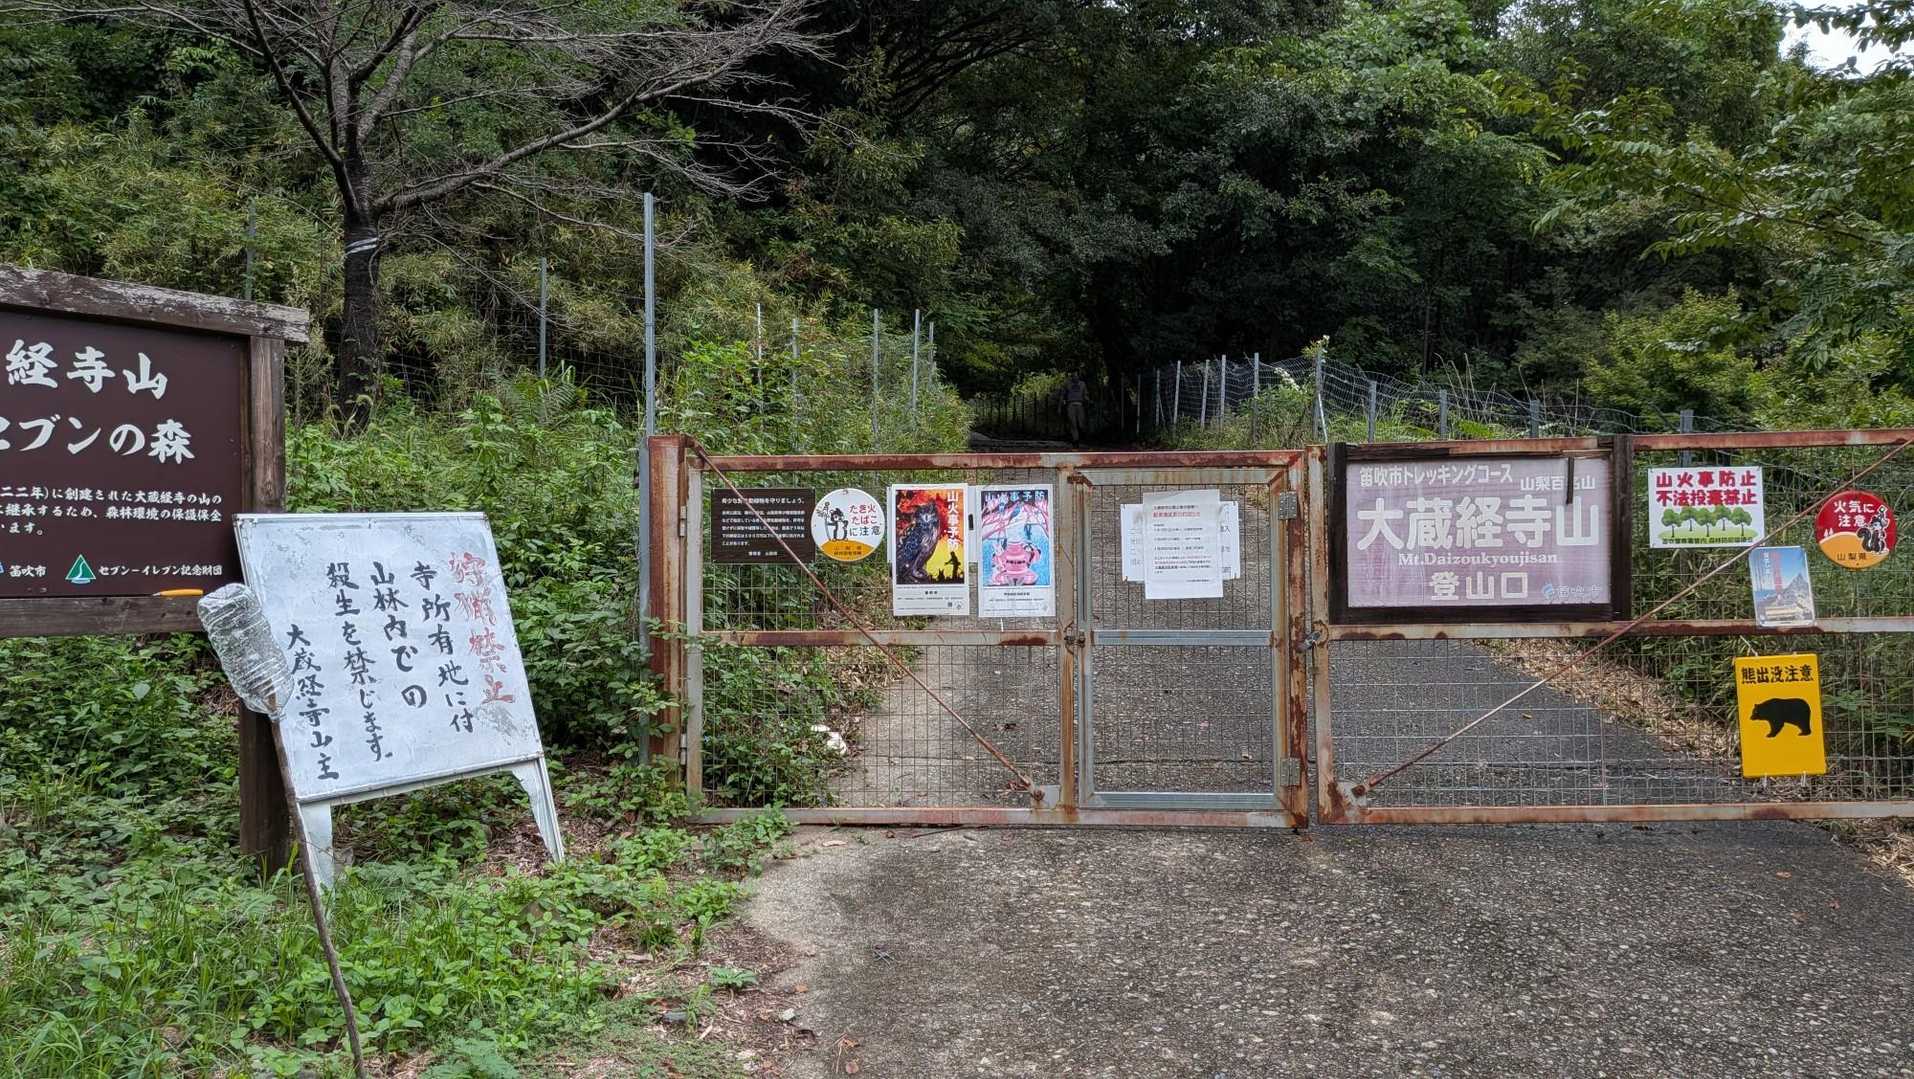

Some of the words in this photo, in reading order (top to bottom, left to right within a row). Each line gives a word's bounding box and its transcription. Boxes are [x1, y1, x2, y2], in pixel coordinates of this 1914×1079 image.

[5, 339, 168, 399] 経寺山
[1359, 464, 1513, 487] 笛吹市トレッキングコース
[1656, 471, 1757, 488] 山火事防止
[1656, 489, 1757, 507] 不法投棄禁止
[850, 504, 876, 514] たき火
[1834, 500, 1875, 513] 火気に
[852, 515, 877, 525] たばこ
[1357, 495, 1600, 551] 大蔵経寺山
[1838, 514, 1868, 528] 注意
[0, 522, 43, 536] ます。
[850, 526, 880, 536] に注意
[1398, 552, 1558, 568] Mt.Daizoukyoujisan
[10, 565, 46, 577] 笛吹市
[1430, 571, 1529, 600] 登山口
[370, 561, 428, 708] 山林内での
[1741, 666, 1815, 685] 熊出没注意
